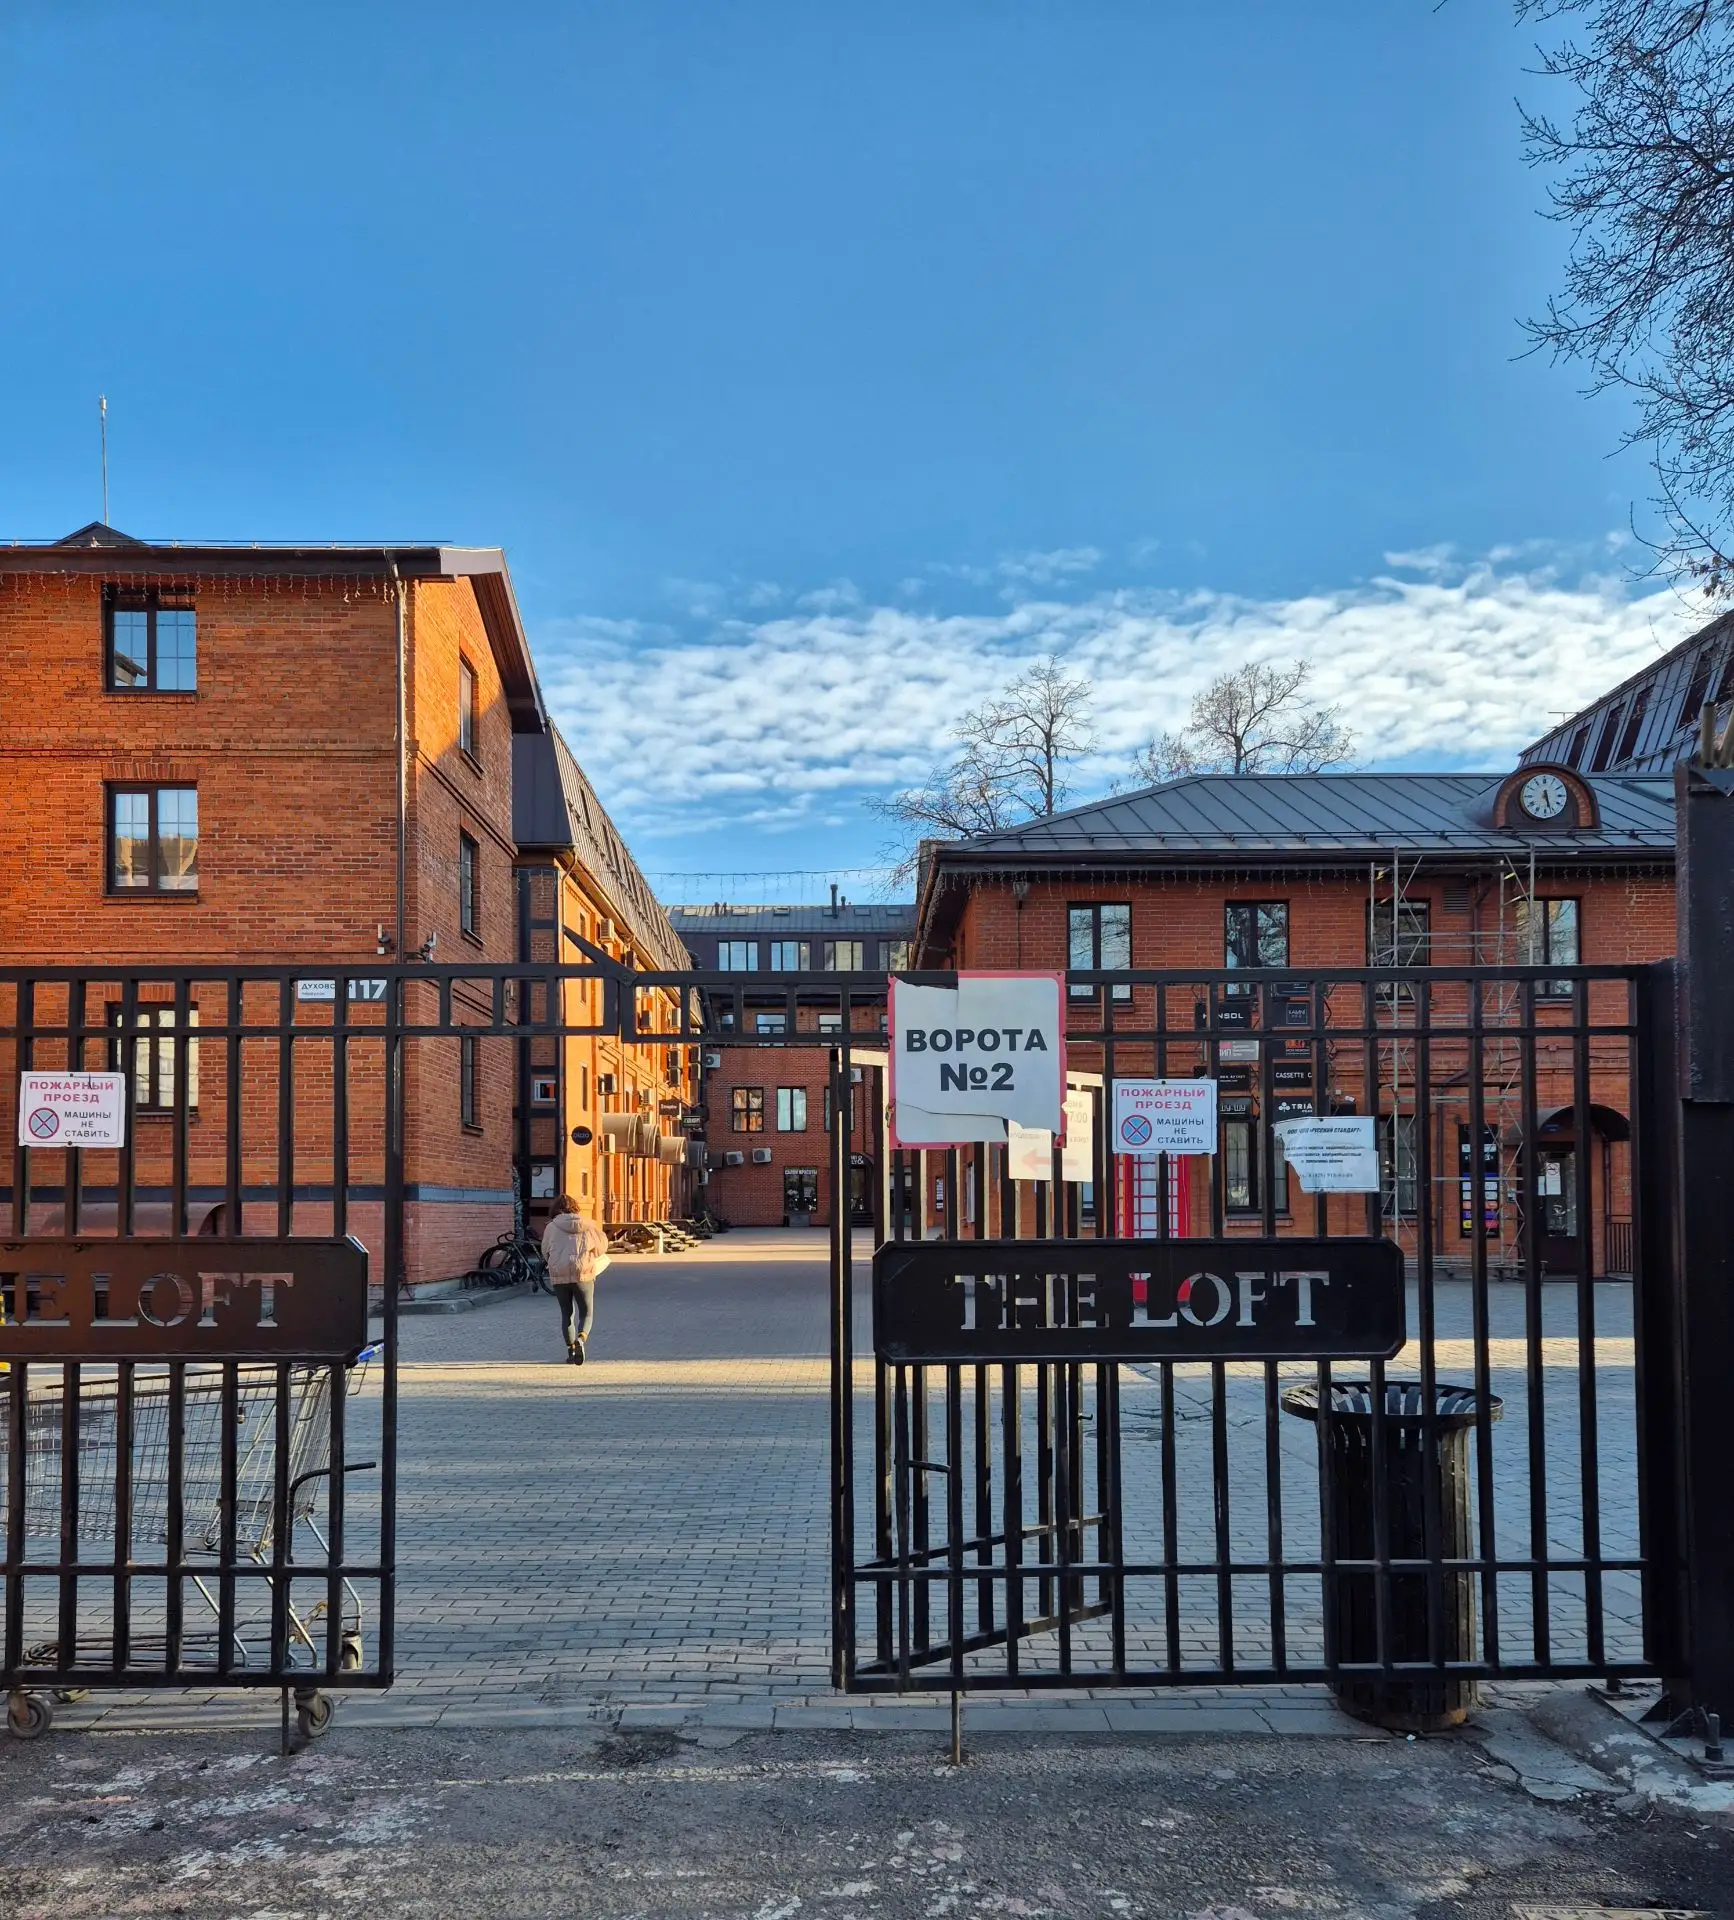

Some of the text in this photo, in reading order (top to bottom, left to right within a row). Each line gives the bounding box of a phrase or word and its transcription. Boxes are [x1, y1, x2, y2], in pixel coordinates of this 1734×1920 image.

[906, 1028, 1048, 1052] ВОРОТА
[940, 1062, 1015, 1092] №2
[29, 1081, 114, 1090] ПОЖАРНЫЙ
[1121, 1087, 1206, 1097] ПОЖАРНЫЙ
[43, 1093, 99, 1103] ПРОЕЗД
[1135, 1100, 1192, 1110] ПРОЕЗД
[64, 1111, 111, 1119] МАШИНЫ
[1156, 1118, 1204, 1126] МАШИНЫ
[64, 1130, 110, 1138] СТАВИТЬ
[1174, 1127, 1188, 1135] НЕ
[1157, 1136, 1204, 1144] СТАВИТЬ
[90, 1272, 295, 1327] LOFT
[946, 1272, 1330, 1330] THE LOFT
